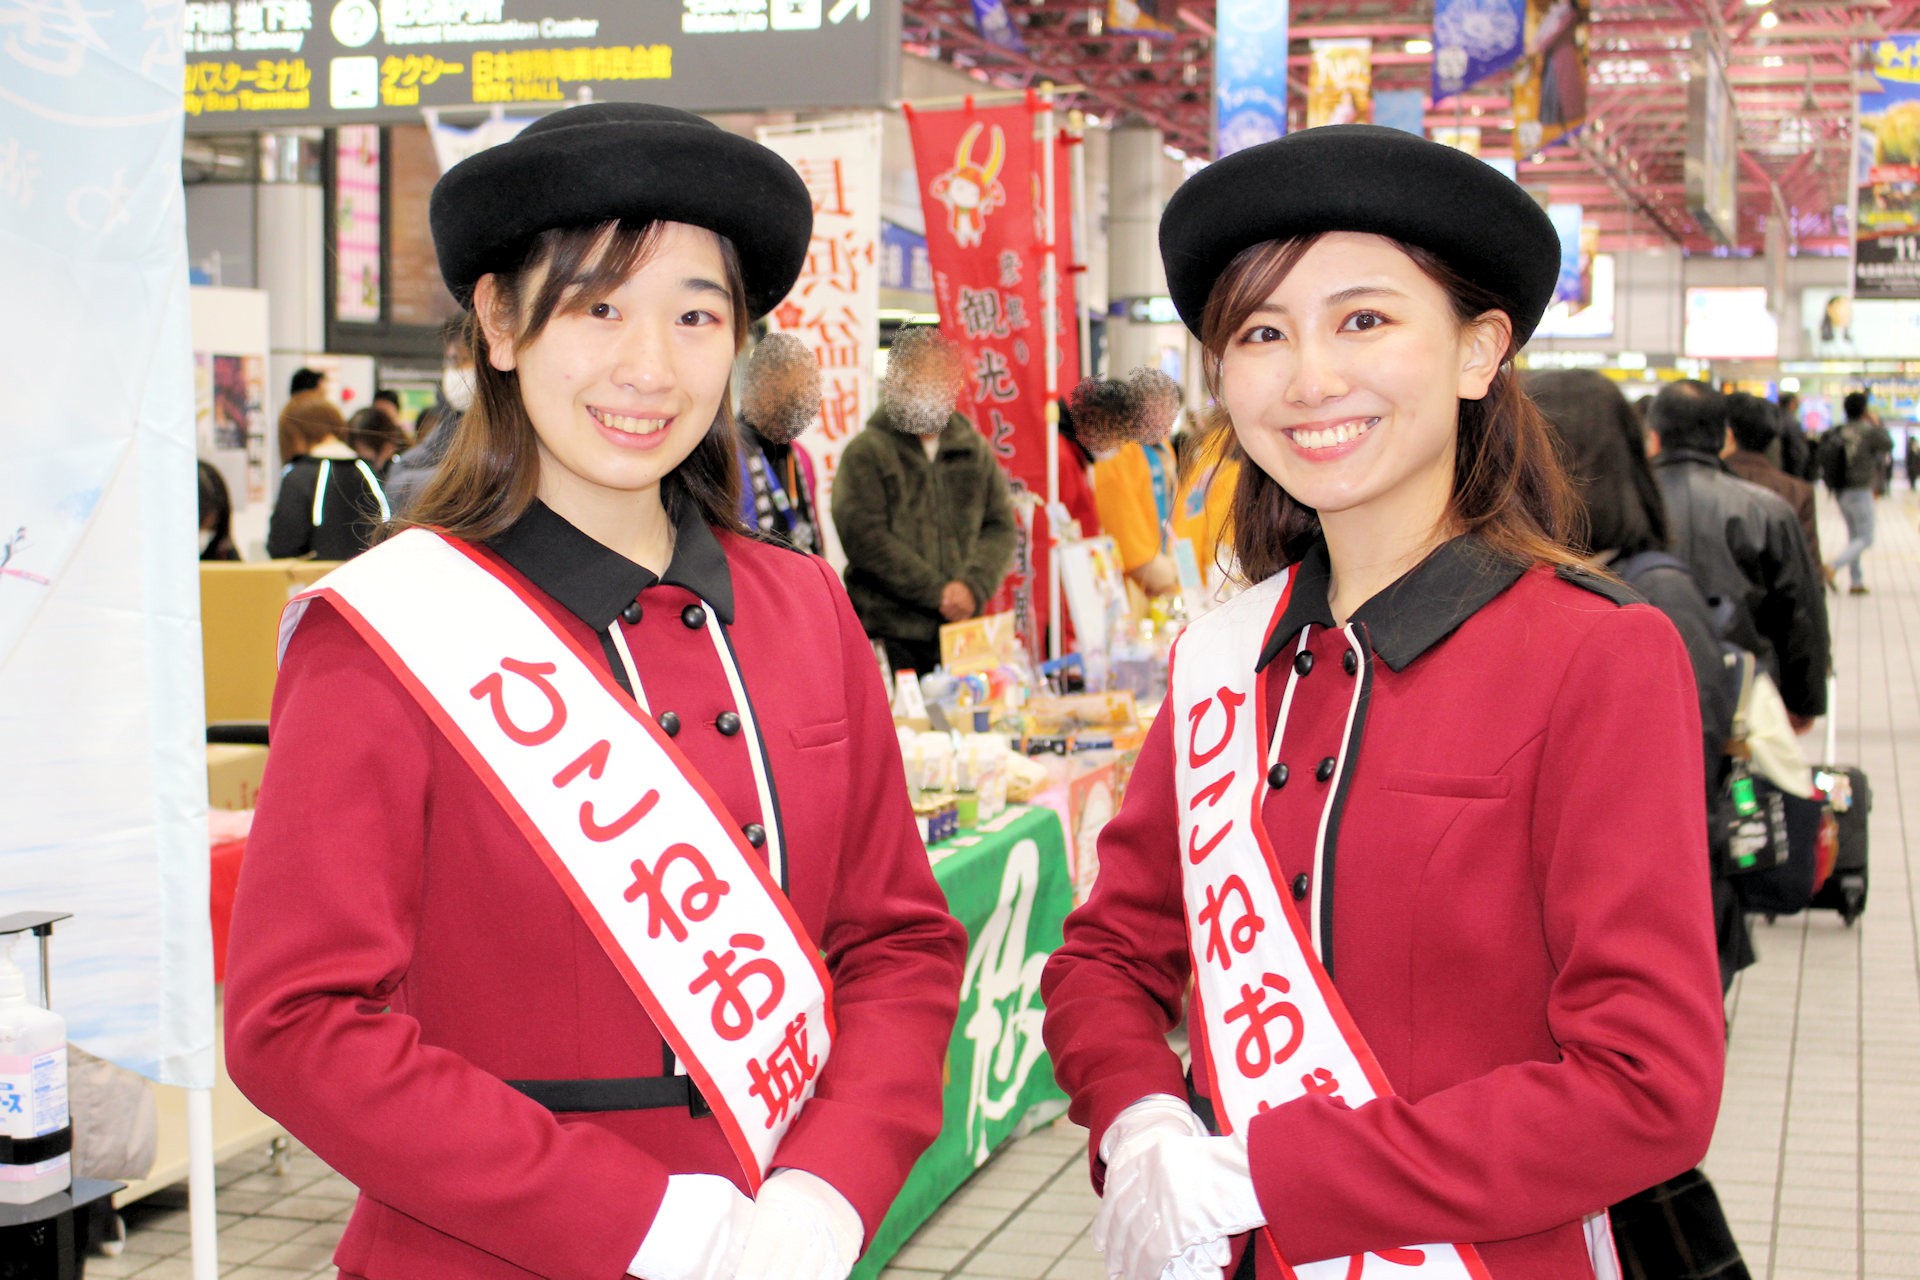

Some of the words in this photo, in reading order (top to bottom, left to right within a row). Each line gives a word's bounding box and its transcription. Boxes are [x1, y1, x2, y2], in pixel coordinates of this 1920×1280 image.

[184, 58, 312, 92] バスターミナル
[381, 54, 464, 86] タクシー
[469, 656, 819, 1135] ひこねお城
